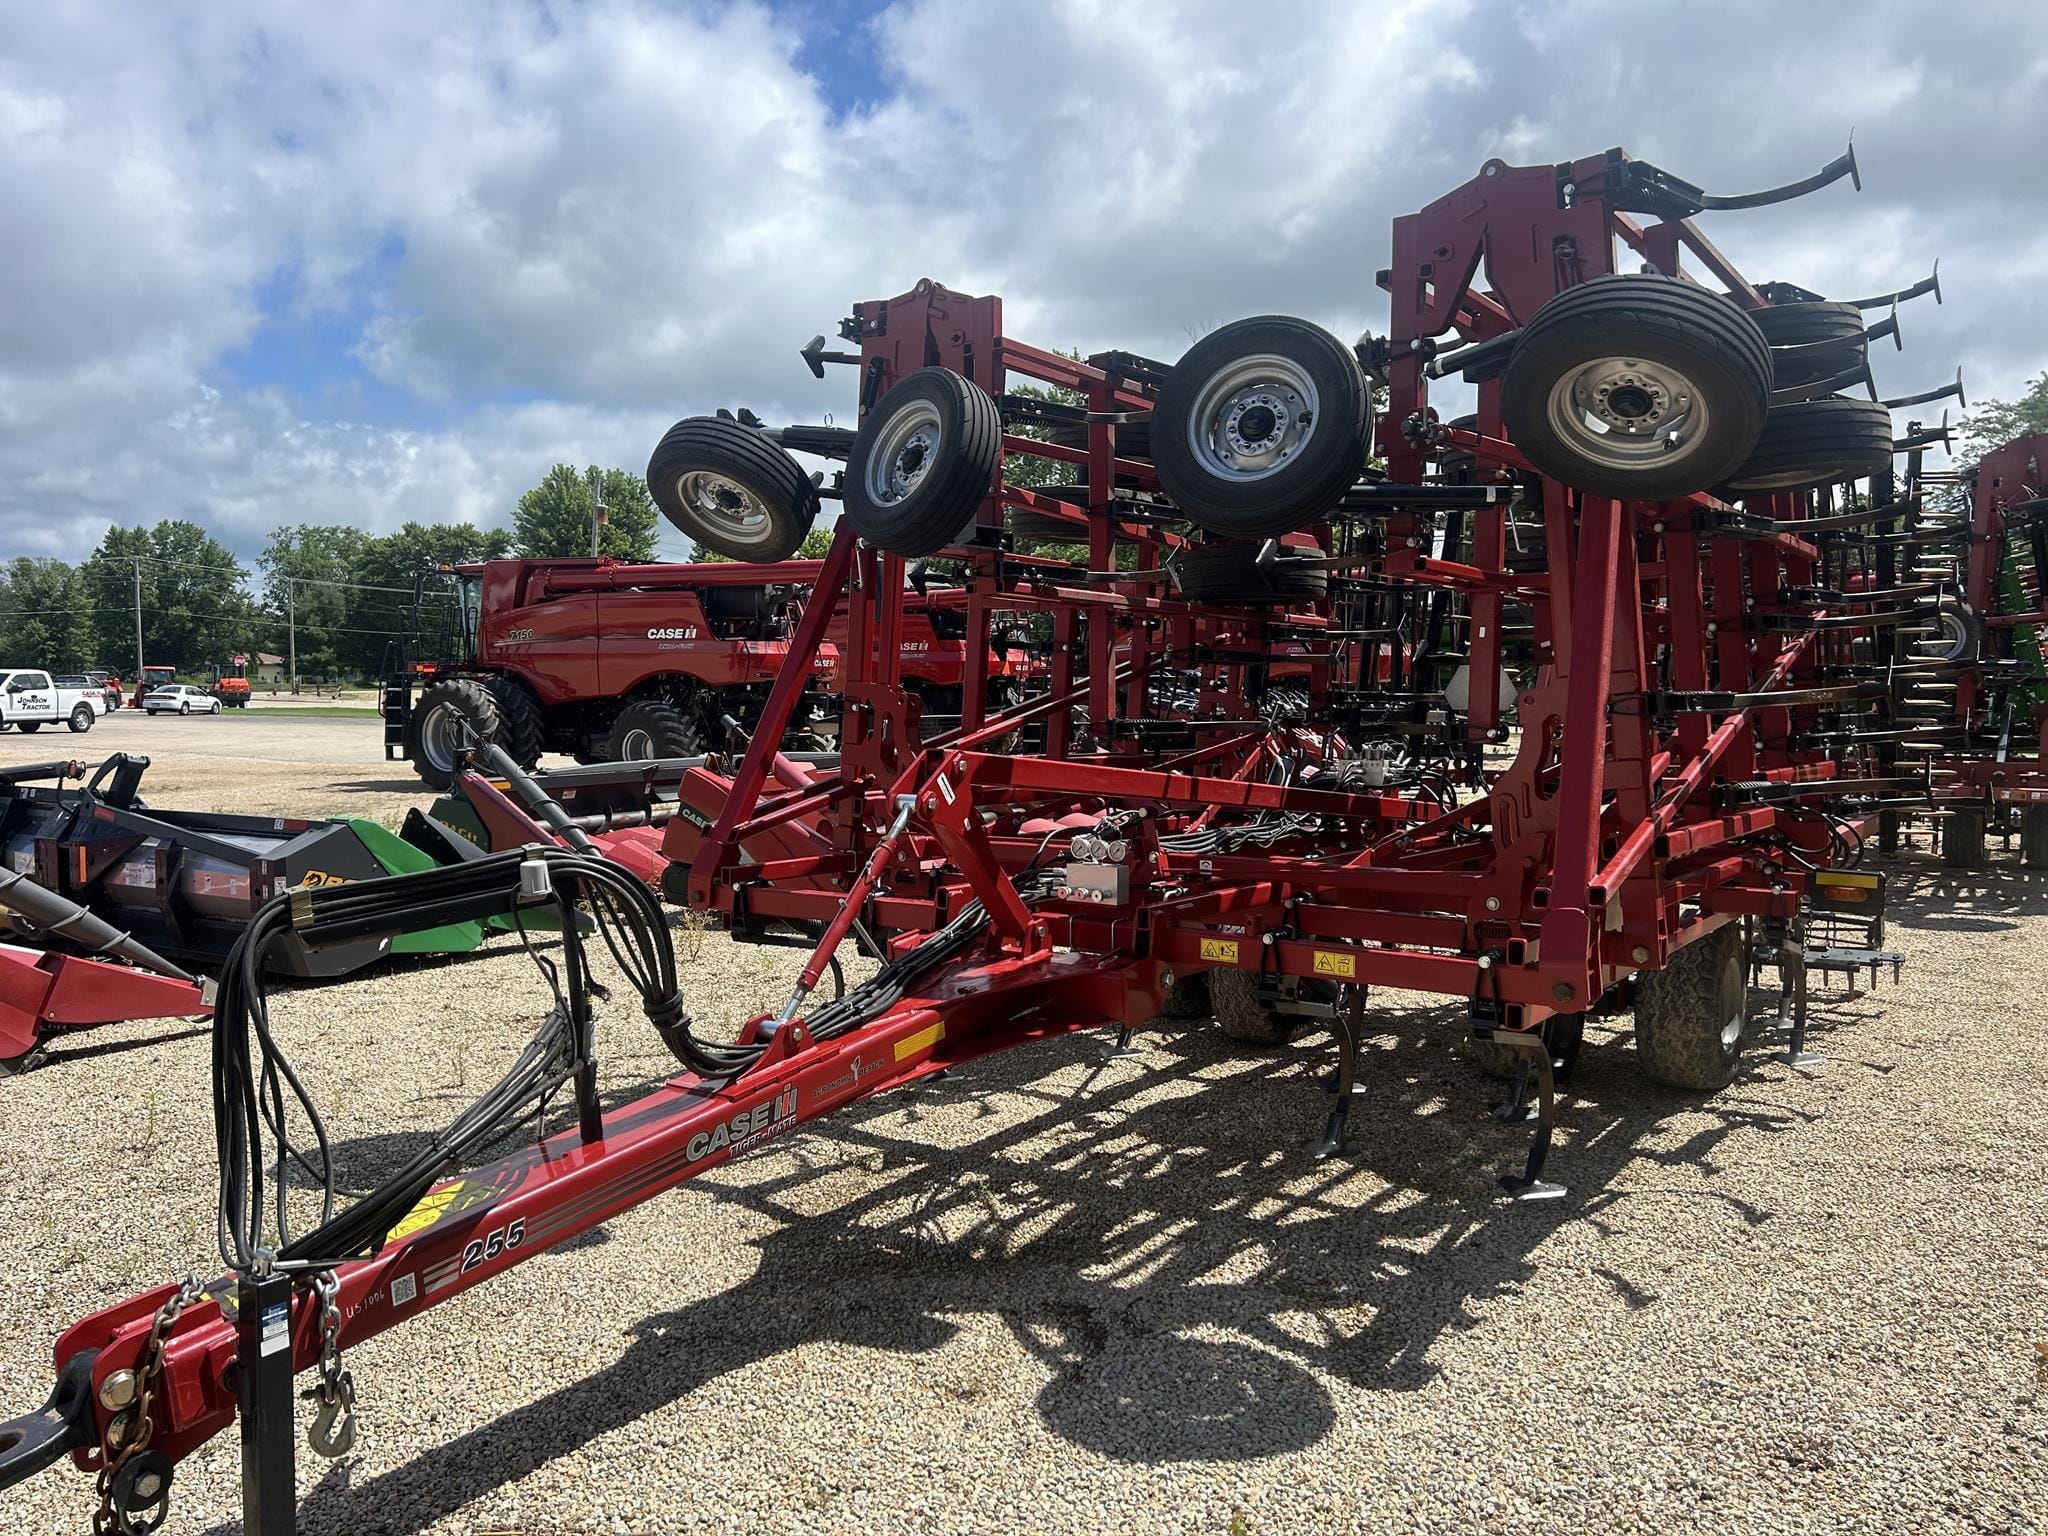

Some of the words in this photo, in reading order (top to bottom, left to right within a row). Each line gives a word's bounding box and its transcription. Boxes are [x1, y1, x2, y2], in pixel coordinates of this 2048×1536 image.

[510, 628, 535, 640] 7150
[647, 628, 684, 639] CASE
[22, 703, 51, 711] TRACTOR
[685, 1101, 771, 1163] CASE
[728, 1114, 797, 1156] TIGER-MATE
[460, 1217, 527, 1275] 255
